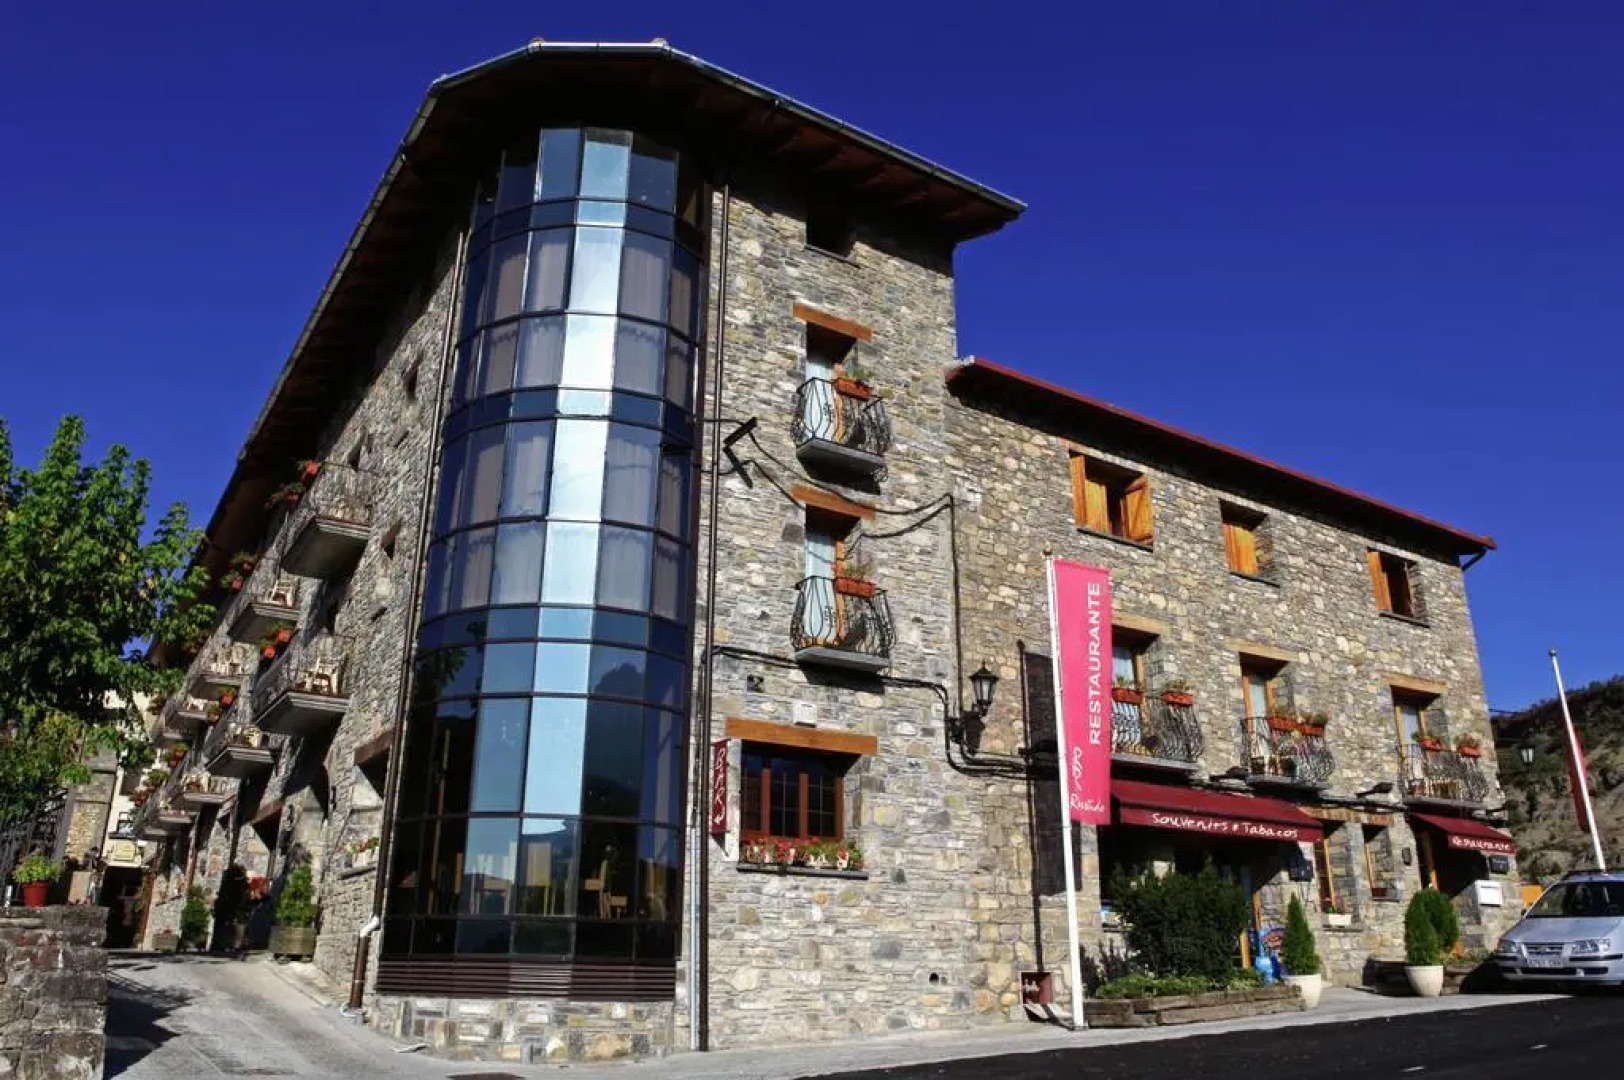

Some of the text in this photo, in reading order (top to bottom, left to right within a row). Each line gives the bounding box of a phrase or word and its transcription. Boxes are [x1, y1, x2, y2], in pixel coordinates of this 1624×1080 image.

[1087, 582, 1101, 745] RESTAURANTE
[1152, 812, 1298, 838] Souvenirs Tabacos
